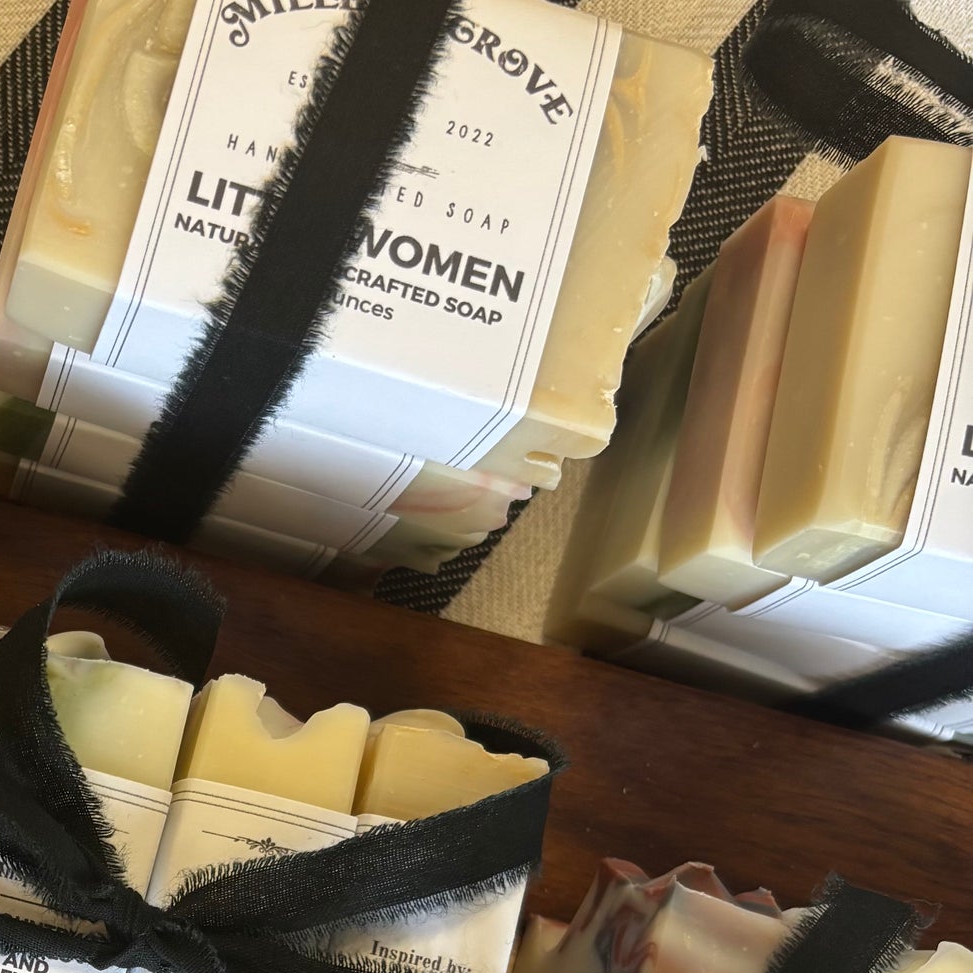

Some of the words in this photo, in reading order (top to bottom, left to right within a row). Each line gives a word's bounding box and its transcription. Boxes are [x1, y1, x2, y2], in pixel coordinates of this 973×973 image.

[446, 120, 494, 147] 2022
[446, 202, 510, 235] SOAP
[443, 296, 503, 326] SOAP
[369, 940, 442, 971] Inspired
